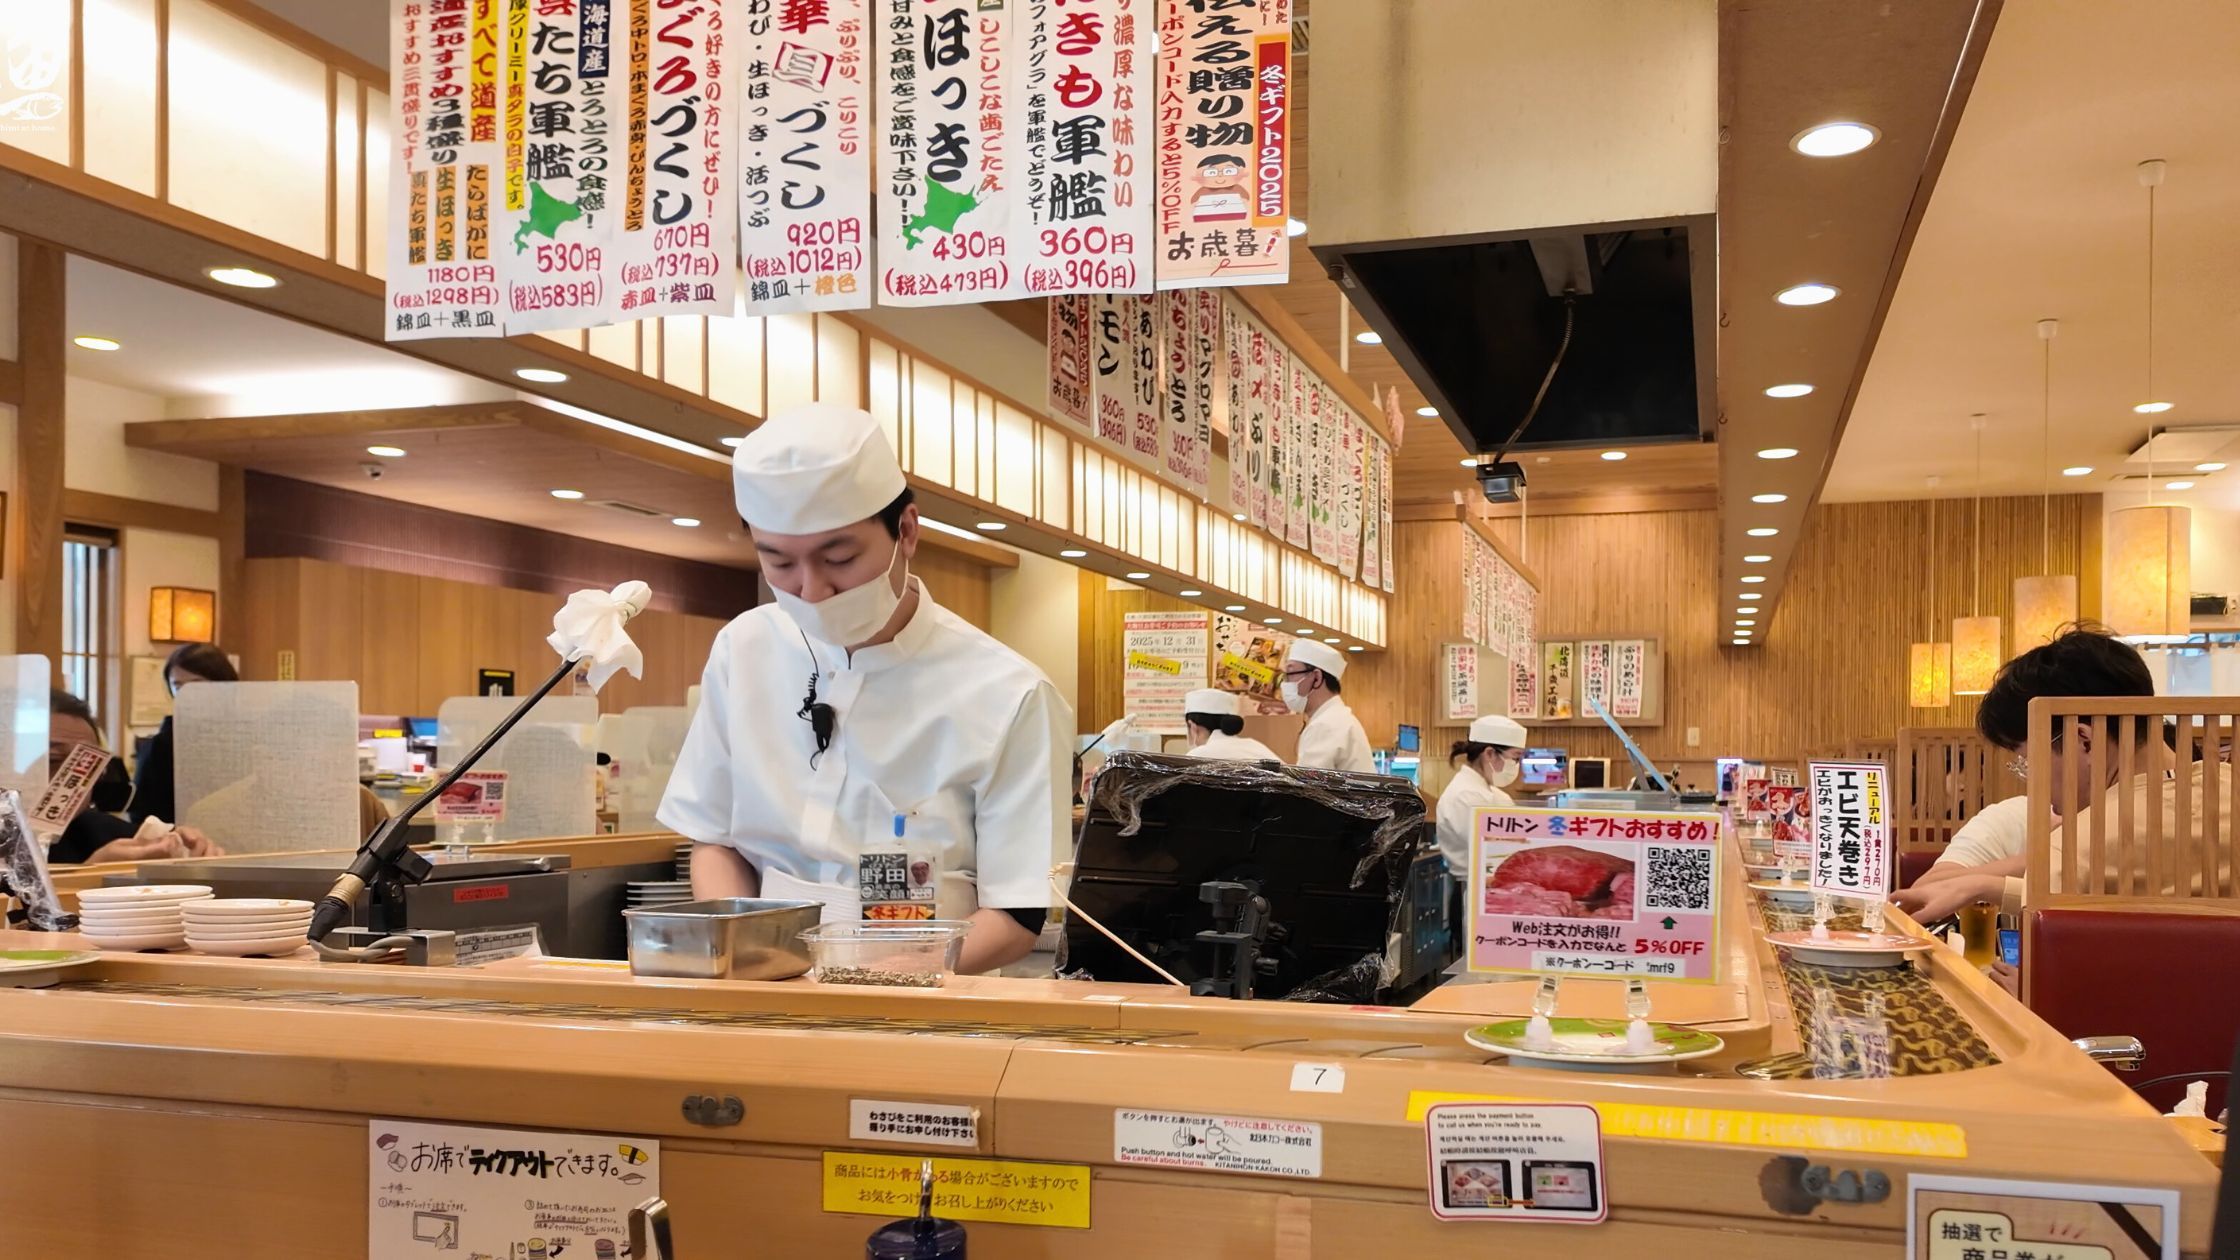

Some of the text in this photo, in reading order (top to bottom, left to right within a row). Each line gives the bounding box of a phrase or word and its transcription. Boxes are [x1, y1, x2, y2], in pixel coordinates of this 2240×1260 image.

[470, 0, 498, 142] すべて道産
[922, 0, 972, 183] ほっき
[978, 17, 1004, 191] しこしこな歯ごたえ
[650, 0, 705, 226] ぐろづくし
[702, 0, 723, 219] ろ好きの方にぜひ!
[1026, 0, 1048, 225] フォアグラ」を軍艦でどうぞ!
[1048, 0, 1108, 223] きも軍艦
[1159, 0, 1185, 235] ーポンコード入力すると5%OFF
[576, 81, 608, 229] とろとろの食感!
[1256, 64, 1286, 217] 冬ギフト2025
[435, 167, 456, 261] 生ほっき
[466, 165, 487, 260] たらばがに
[653, 221, 710, 251] 670円
[787, 217, 861, 248] 920円
[932, 230, 1006, 261] 430円
[1039, 226, 1134, 258] 360円
[427, 264, 495, 284] 1180円
[537, 242, 602, 273] 530円
[621, 251, 720, 286] (税込737円)
[746, 244, 863, 279] (税込1012円)
[1023, 258, 1137, 292] (税込396円)
[509, 273, 603, 314] (税込583円)
[884, 260, 1009, 296] (税込473円)
[393, 285, 500, 309] (税込1298円)
[1867, 771, 1881, 825] リニューアル
[1486, 815, 1720, 841] トリトン 冬ギフトおすすめ!
[1816, 769, 1833, 886] エビがおっきくなりました!
[1837, 771, 1862, 887] エビ天巻き
[860, 868, 906, 884] 野田
[1475, 935, 1628, 954] クーポンコードを入力でなんと
[1512, 920, 1622, 940] Web注文がお得!!
[1312, 1067, 1328, 1086] 7
[1489, 1113, 1513, 1121] payment
[1121, 1146, 1140, 1155] Push
[1141, 1148, 1165, 1157] button
[1196, 1153, 1216, 1161] water
[1121, 1153, 1132, 1161] Be
[1132, 1155, 1158, 1163] careful
[1159, 1157, 1181, 1165] about
[858, 1189, 1055, 1214] お気をつけお召し上がりください
[1941, 1221, 2004, 1244] 抽選で
